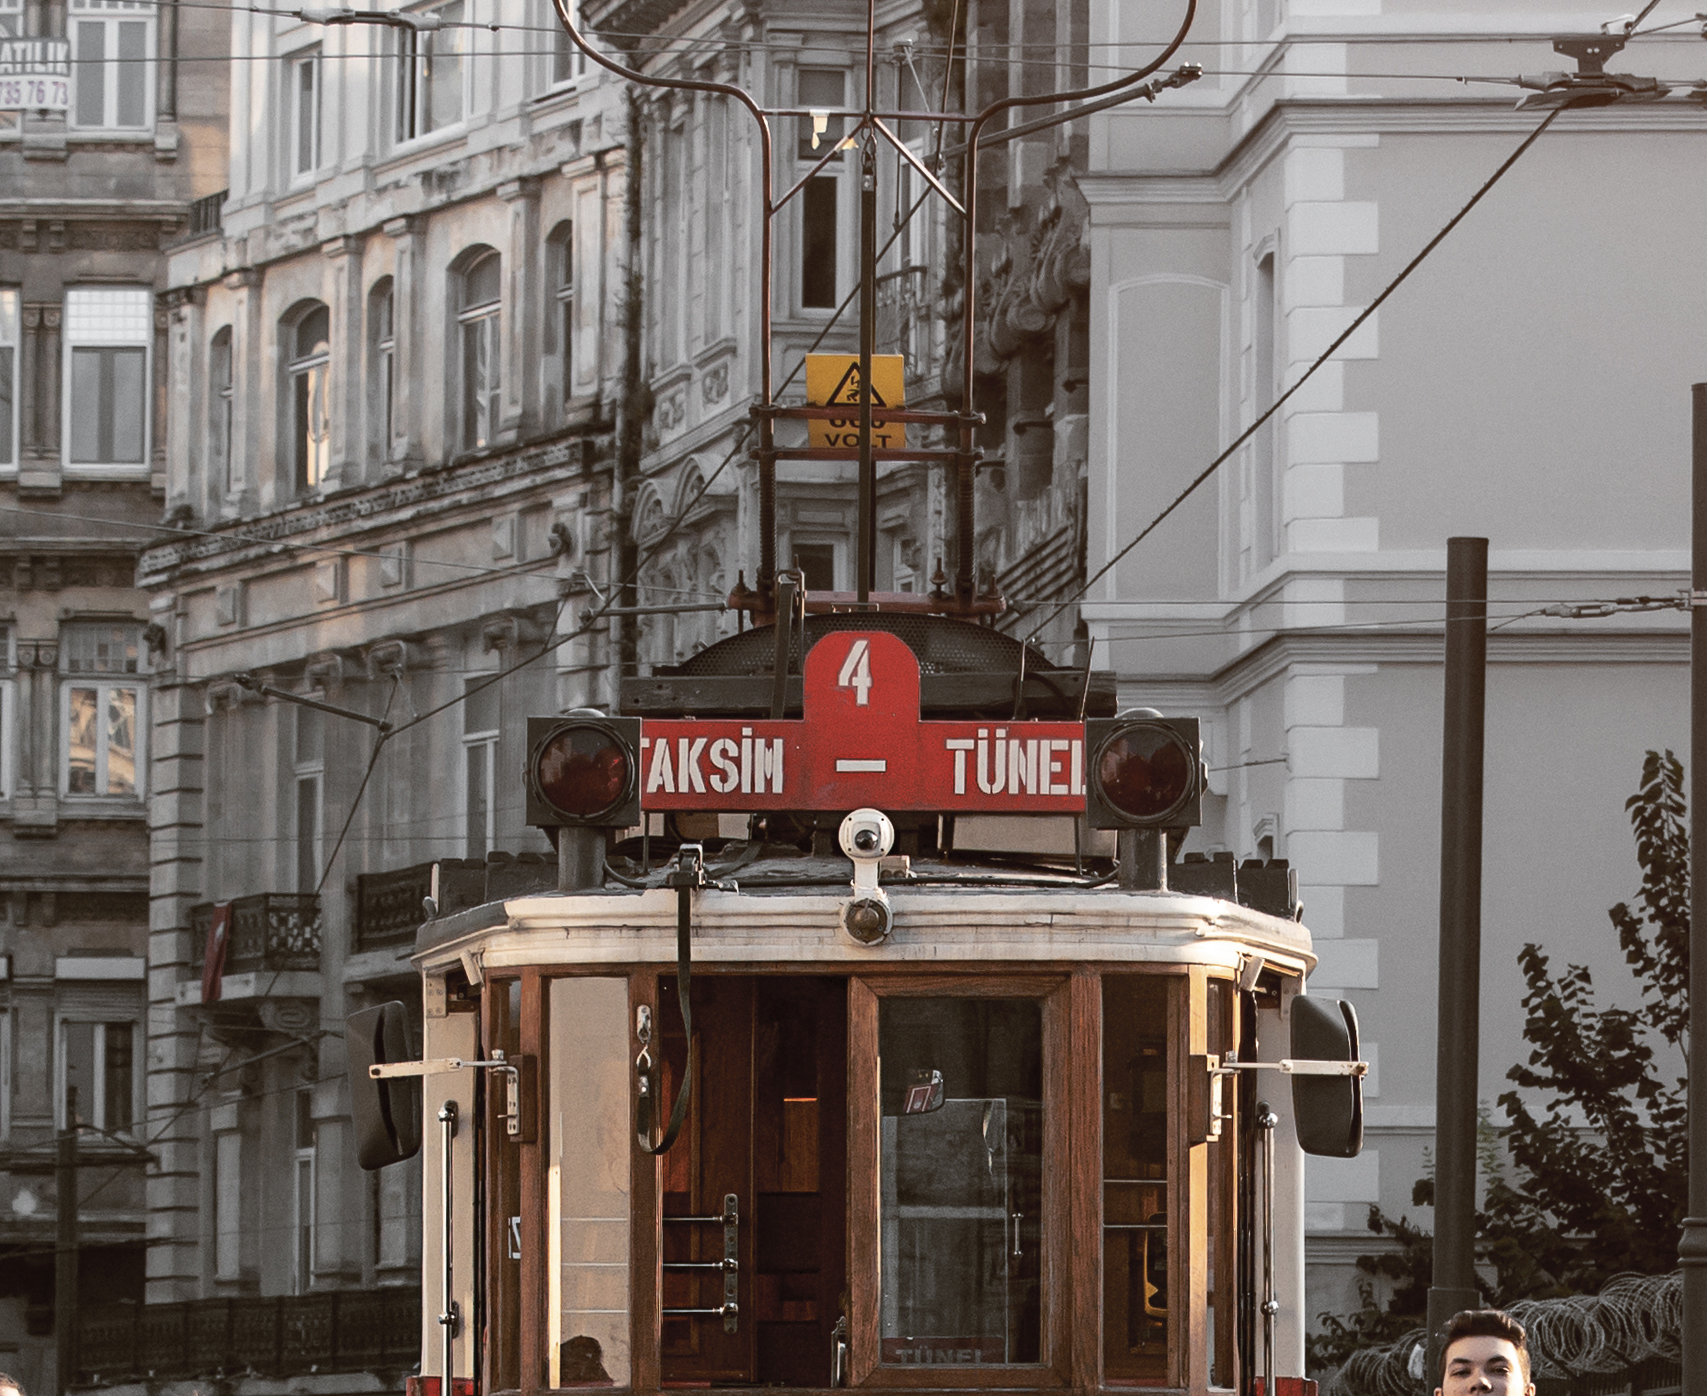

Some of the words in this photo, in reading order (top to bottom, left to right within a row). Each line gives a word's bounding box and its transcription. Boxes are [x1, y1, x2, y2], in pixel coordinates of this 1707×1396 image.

[824, 433, 893, 449] VOT
[838, 639, 873, 706] 4
[641, 727, 784, 794] AKSİM
